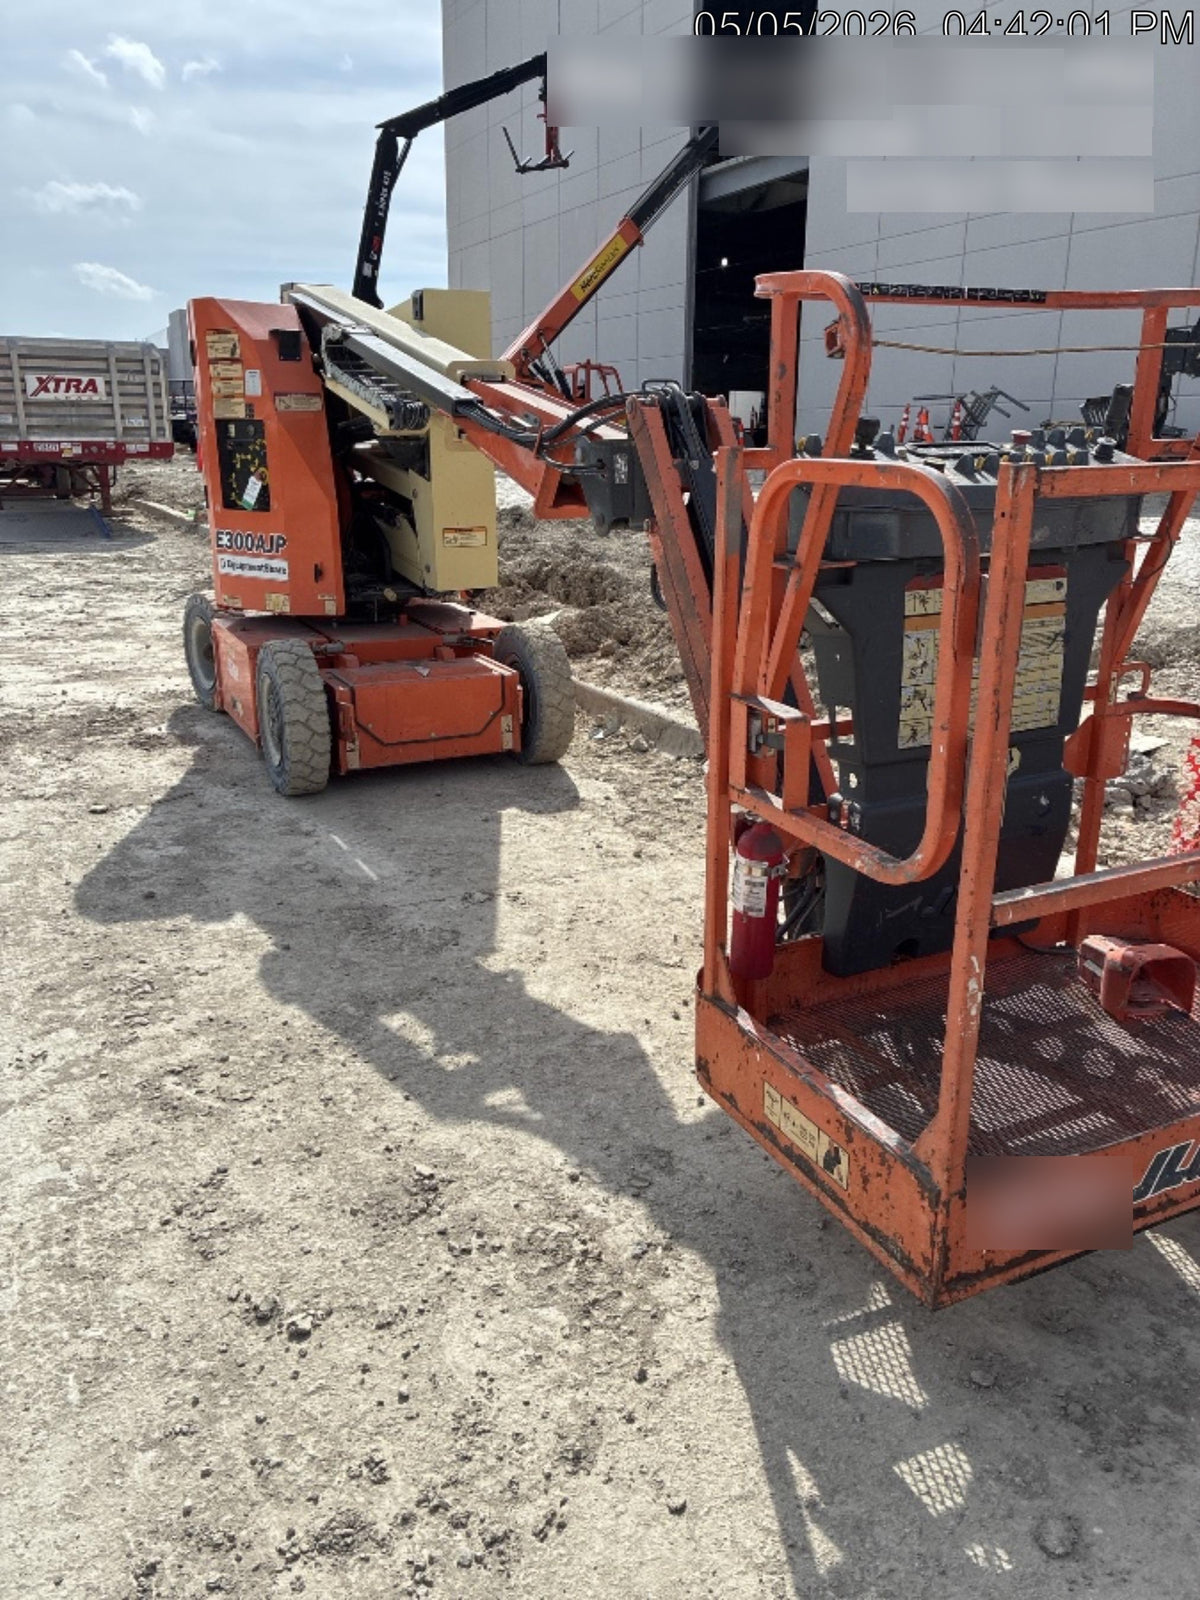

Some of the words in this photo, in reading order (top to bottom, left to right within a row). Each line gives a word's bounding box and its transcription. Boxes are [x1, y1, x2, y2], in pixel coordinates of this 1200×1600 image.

[30, 374, 99, 397] XTRA
[215, 530, 288, 554] E300AJP
[1132, 1139, 1200, 1204] JL
